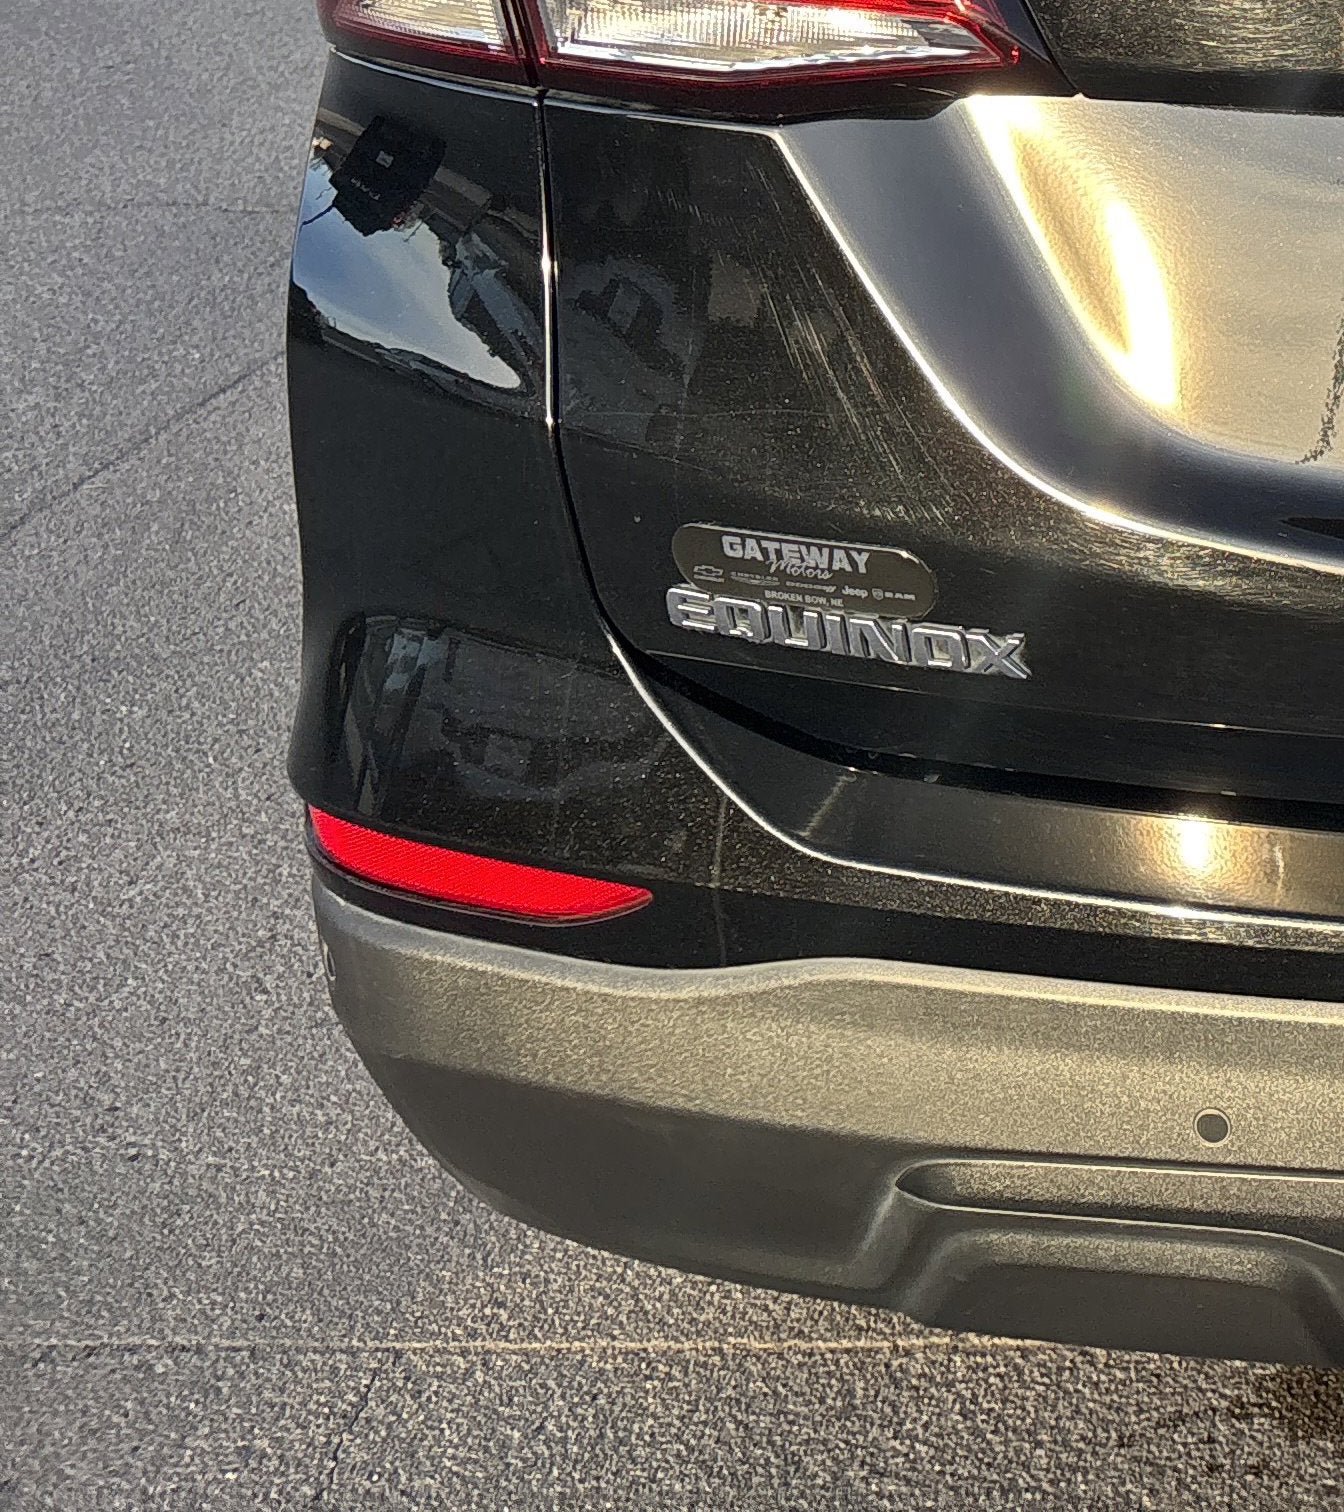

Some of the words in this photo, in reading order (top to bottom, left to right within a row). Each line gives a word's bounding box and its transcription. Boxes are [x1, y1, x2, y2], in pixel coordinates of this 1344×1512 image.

[721, 534, 870, 574] GATEWAY
[766, 558, 833, 580] Motors
[764, 589, 803, 603] BROKEN
[841, 585, 869, 599] Jeep
[665, 587, 1034, 680] EQUINOX
